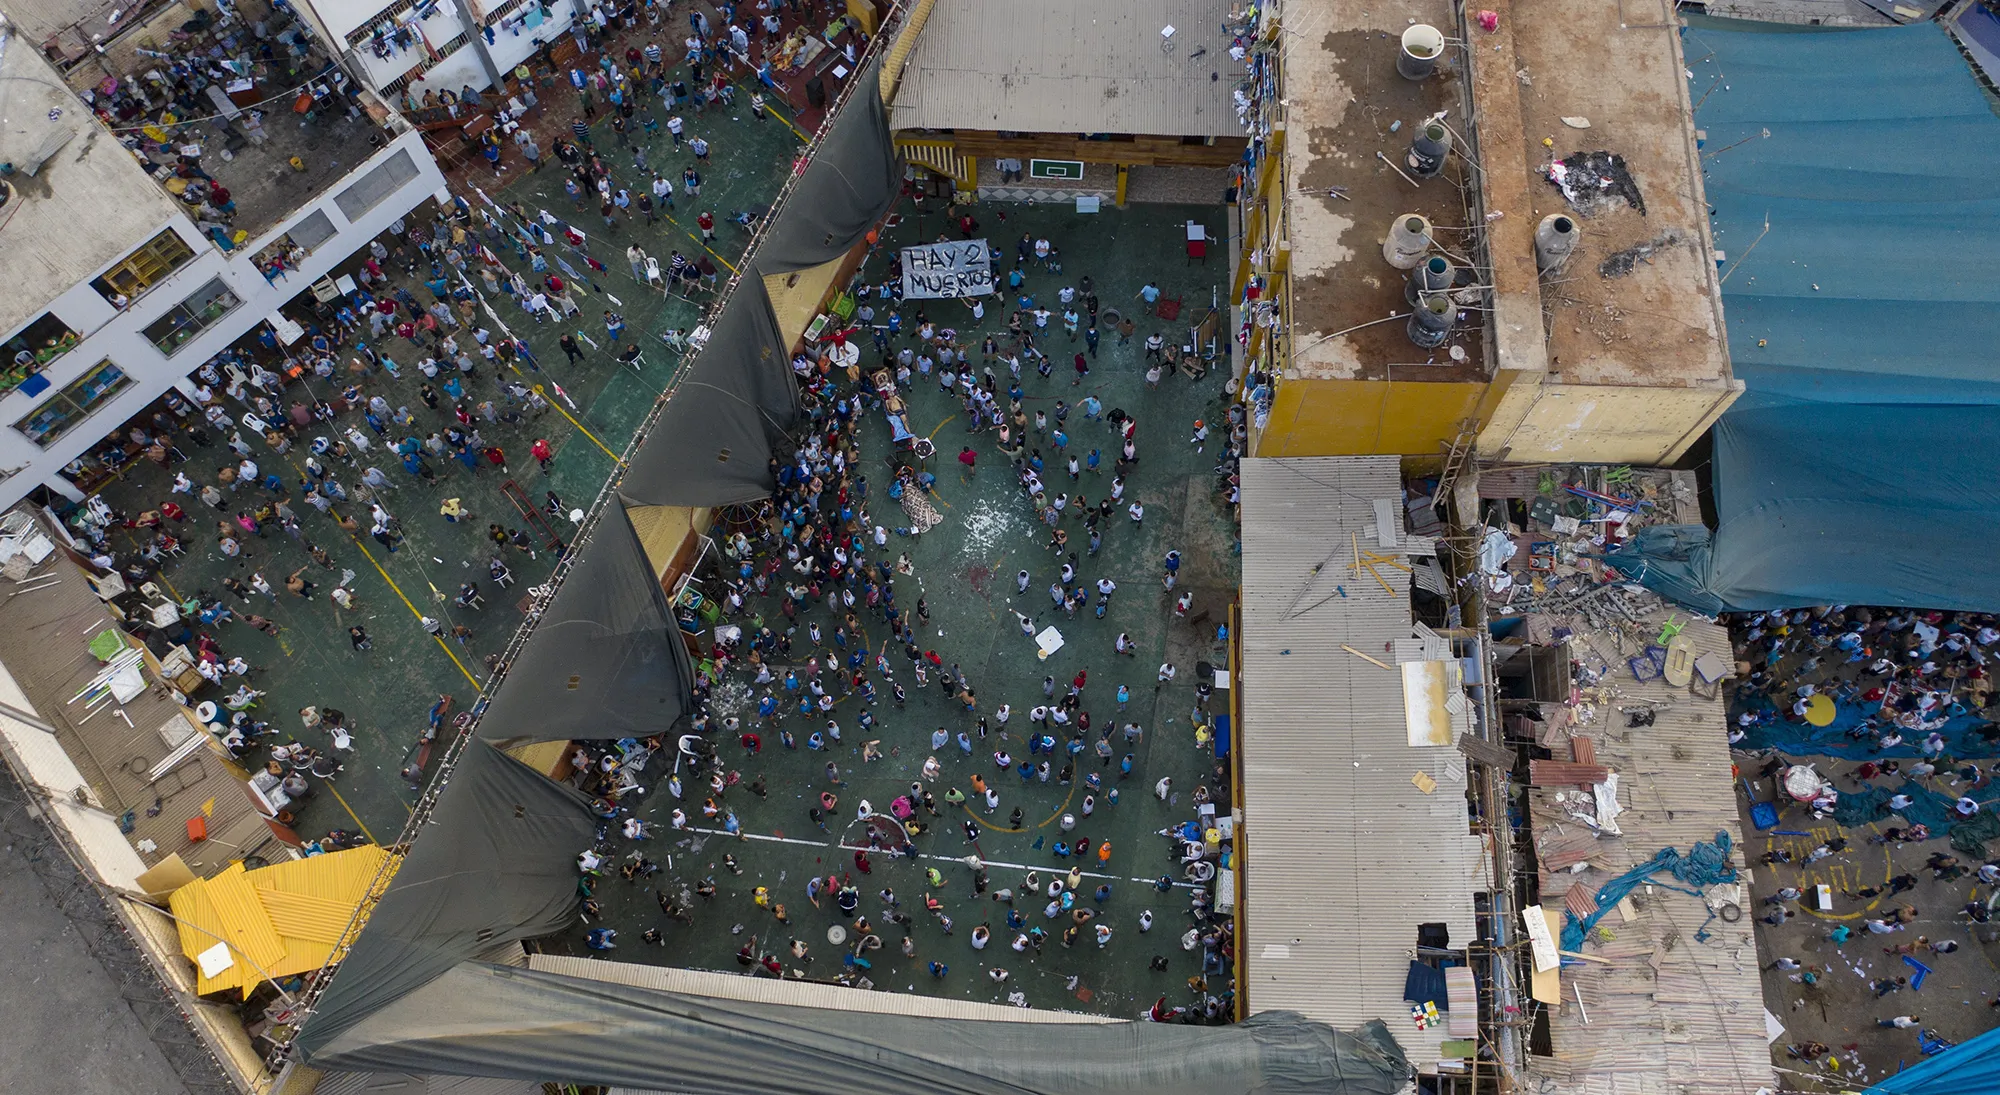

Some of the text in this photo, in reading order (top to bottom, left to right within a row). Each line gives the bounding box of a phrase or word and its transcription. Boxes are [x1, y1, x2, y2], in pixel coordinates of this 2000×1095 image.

[909, 244, 984, 270] HAY 2
[910, 270, 992, 293] MUERTOS
